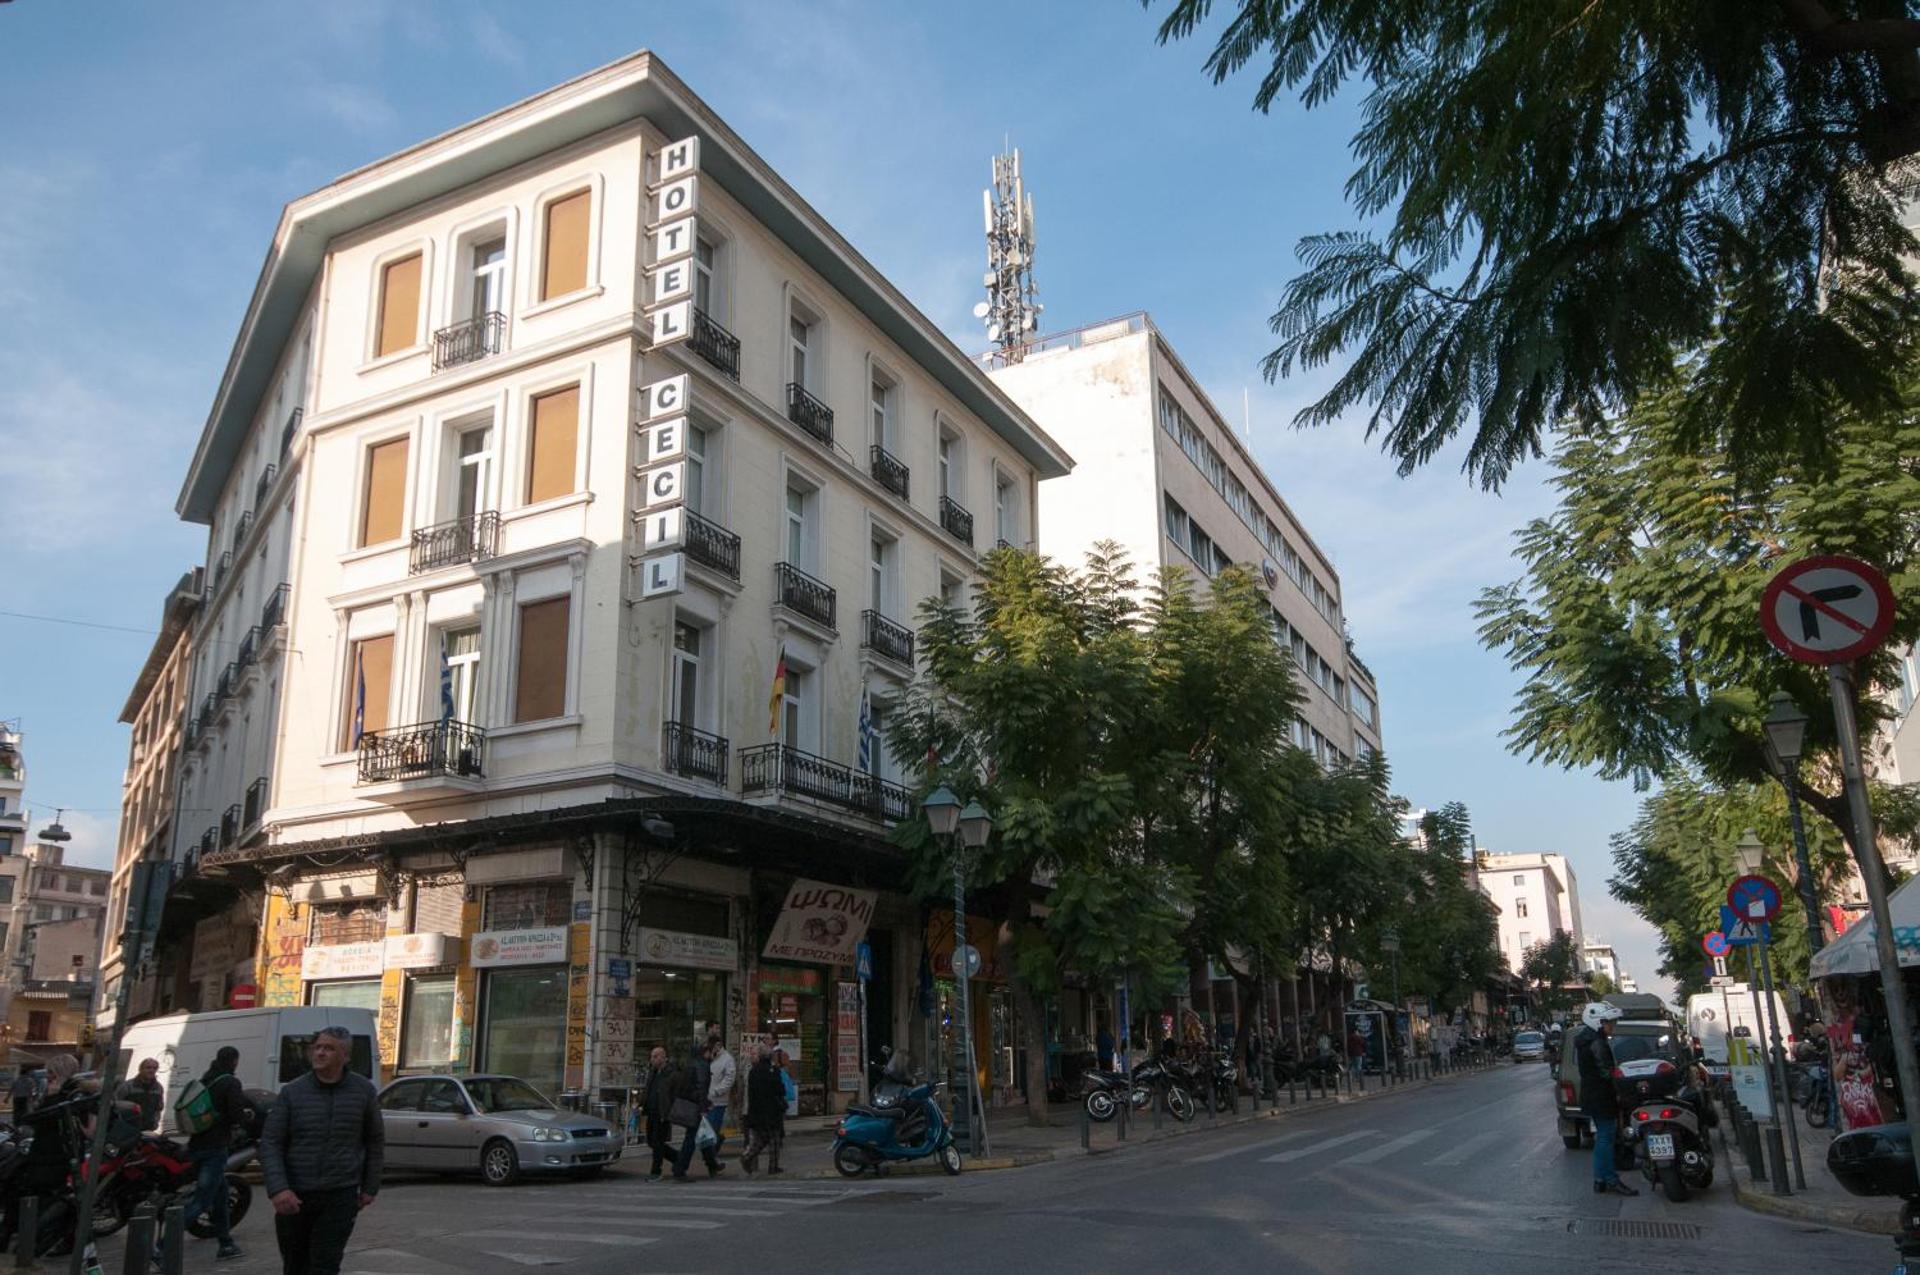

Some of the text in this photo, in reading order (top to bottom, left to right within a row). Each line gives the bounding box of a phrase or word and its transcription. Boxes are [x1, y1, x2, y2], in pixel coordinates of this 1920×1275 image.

[661, 143, 687, 337] HOTEL
[650, 381, 677, 592] CECIL
[790, 889, 872, 925] ΨΩΜΙ
